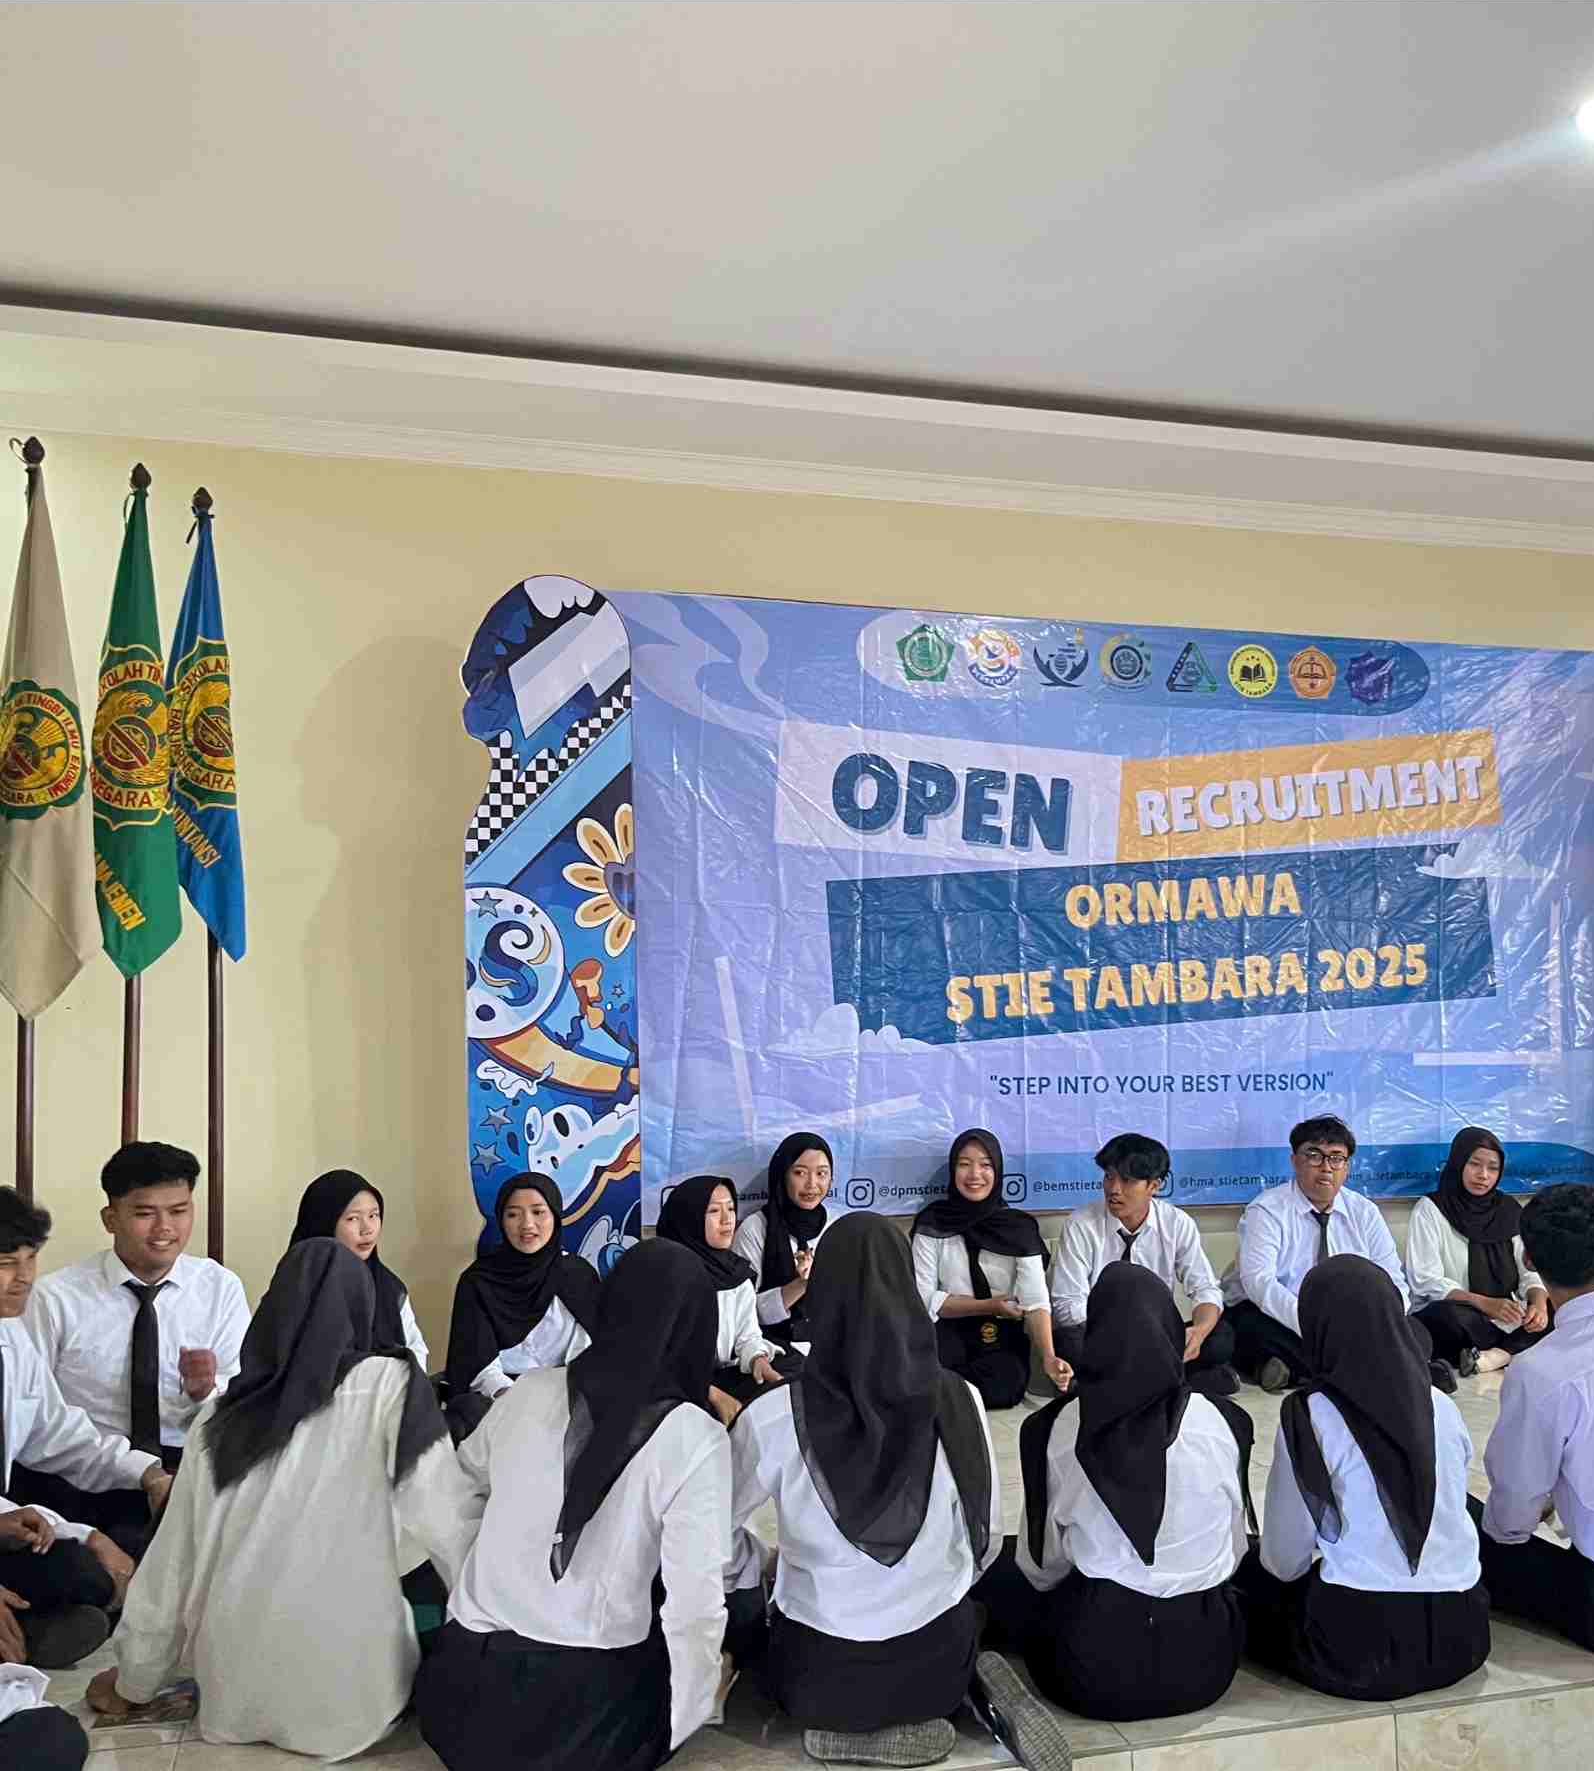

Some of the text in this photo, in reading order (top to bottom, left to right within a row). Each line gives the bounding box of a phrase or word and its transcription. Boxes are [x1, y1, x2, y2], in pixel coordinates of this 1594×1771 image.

[832, 752, 1484, 854] OPEN RECRUITMENT
[1065, 873, 1301, 929] ORMAWA
[945, 943, 1428, 1024] STIE TAMBARA 2025
[990, 1071, 1335, 1096] "STEP INTO YOUR BEST VERSION"
